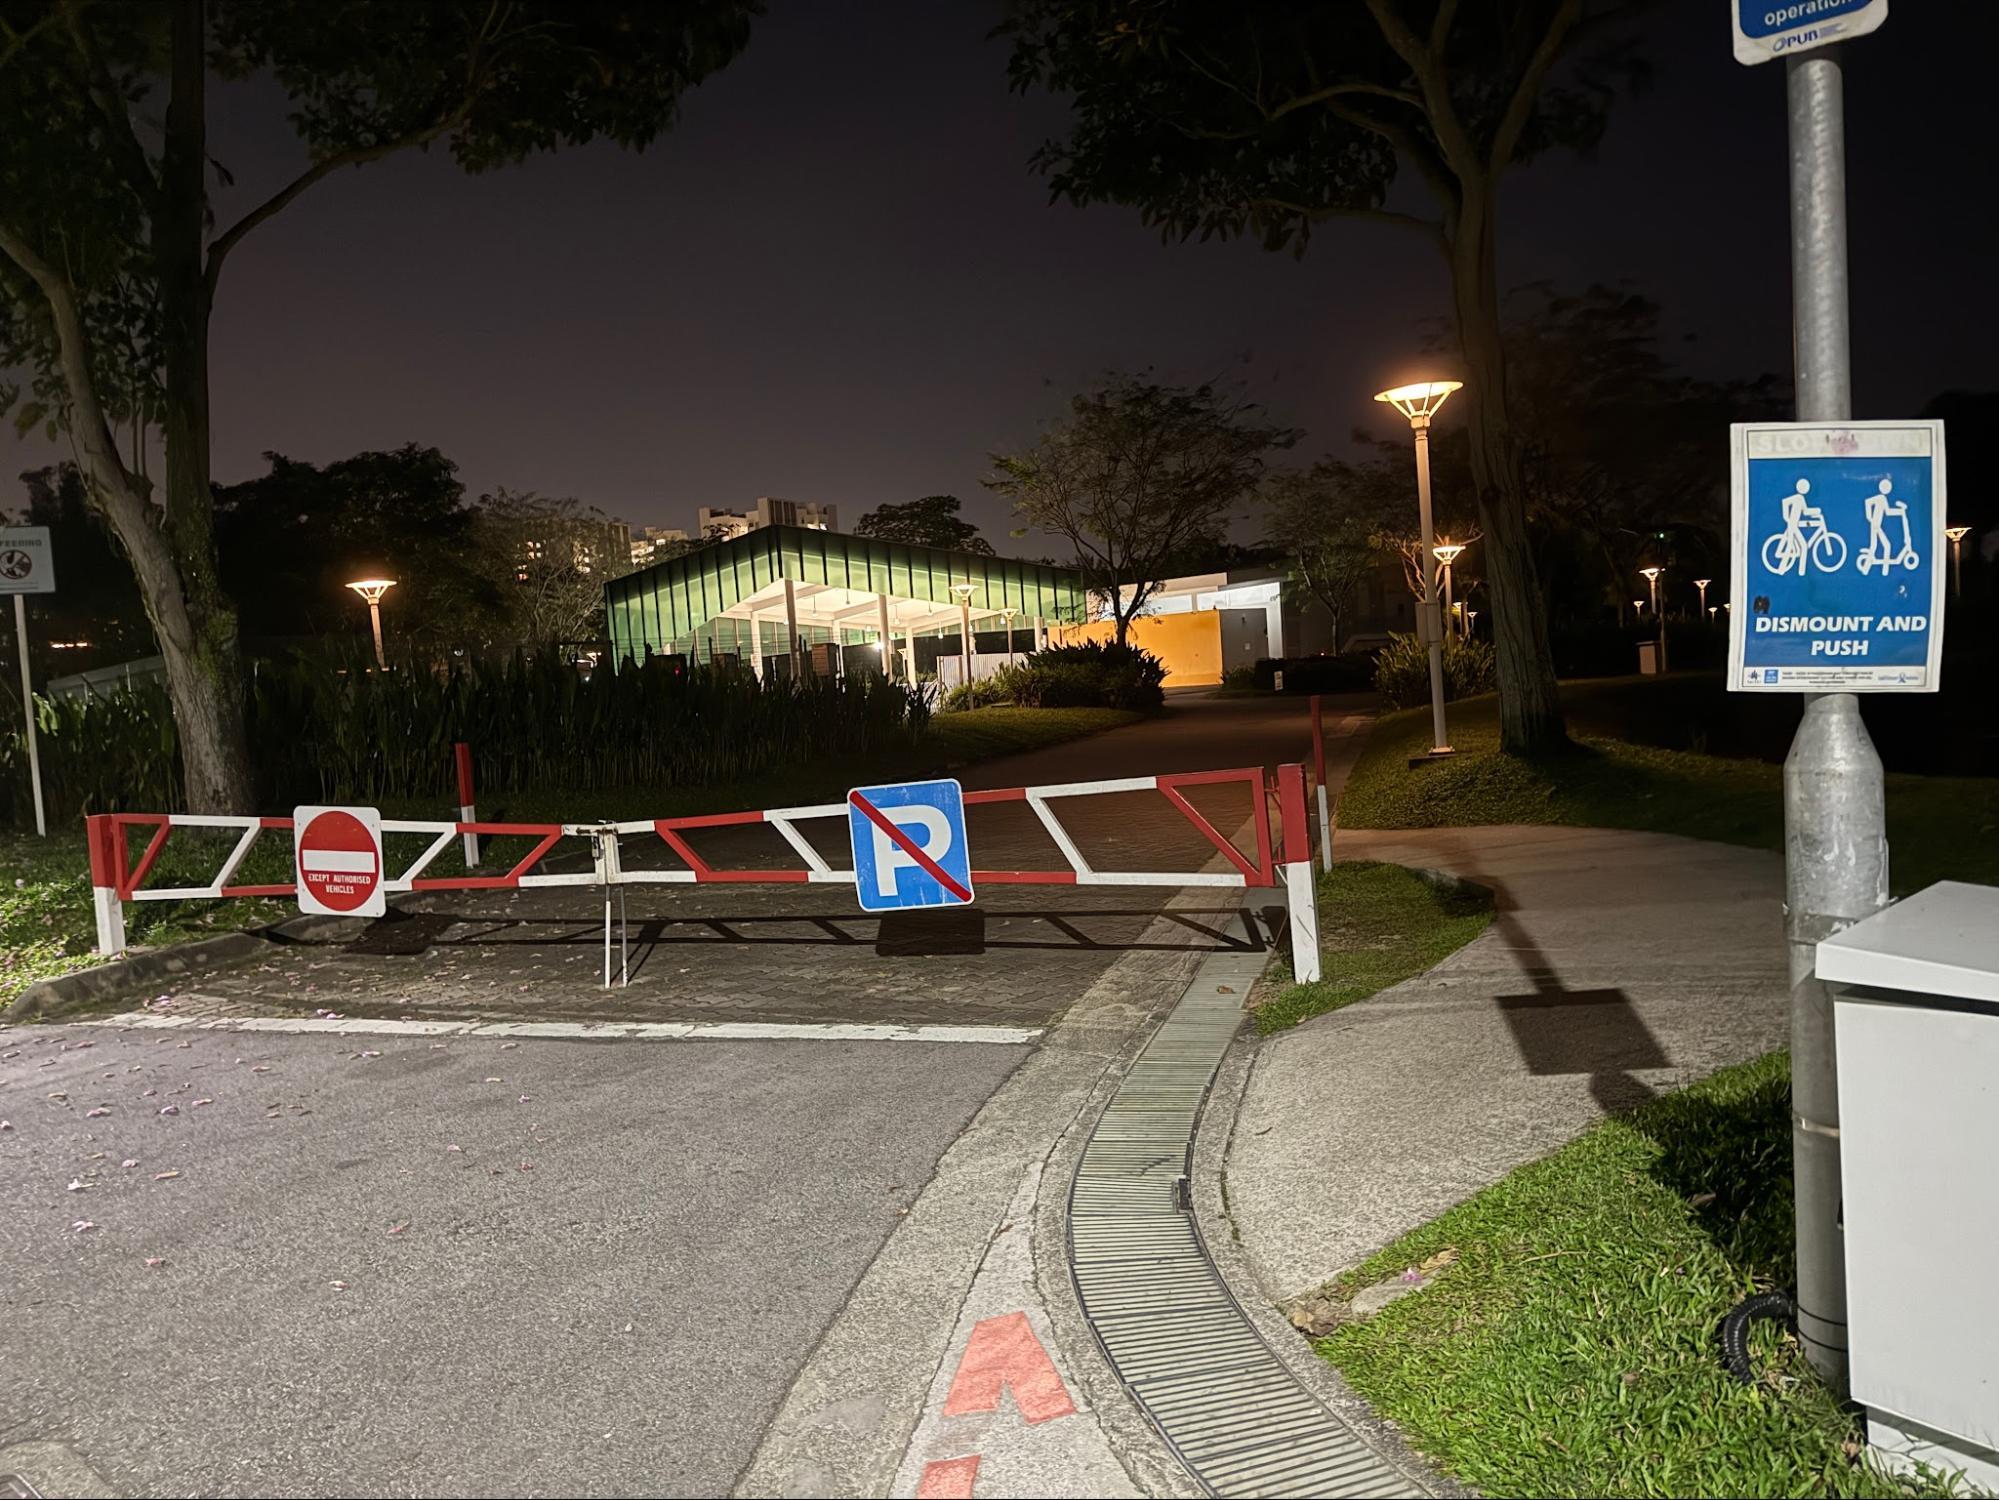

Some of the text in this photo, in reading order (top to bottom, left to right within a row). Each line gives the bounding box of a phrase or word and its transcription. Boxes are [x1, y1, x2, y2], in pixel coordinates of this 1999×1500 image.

[1787, 30, 1818, 47] PUB
[1755, 616, 1928, 633] DISMOUNT AND
[1811, 640, 1869, 656] PUSH
[308, 873, 371, 885] EXCEPT AUTHORISED
[325, 884, 355, 894] VEHICLES
